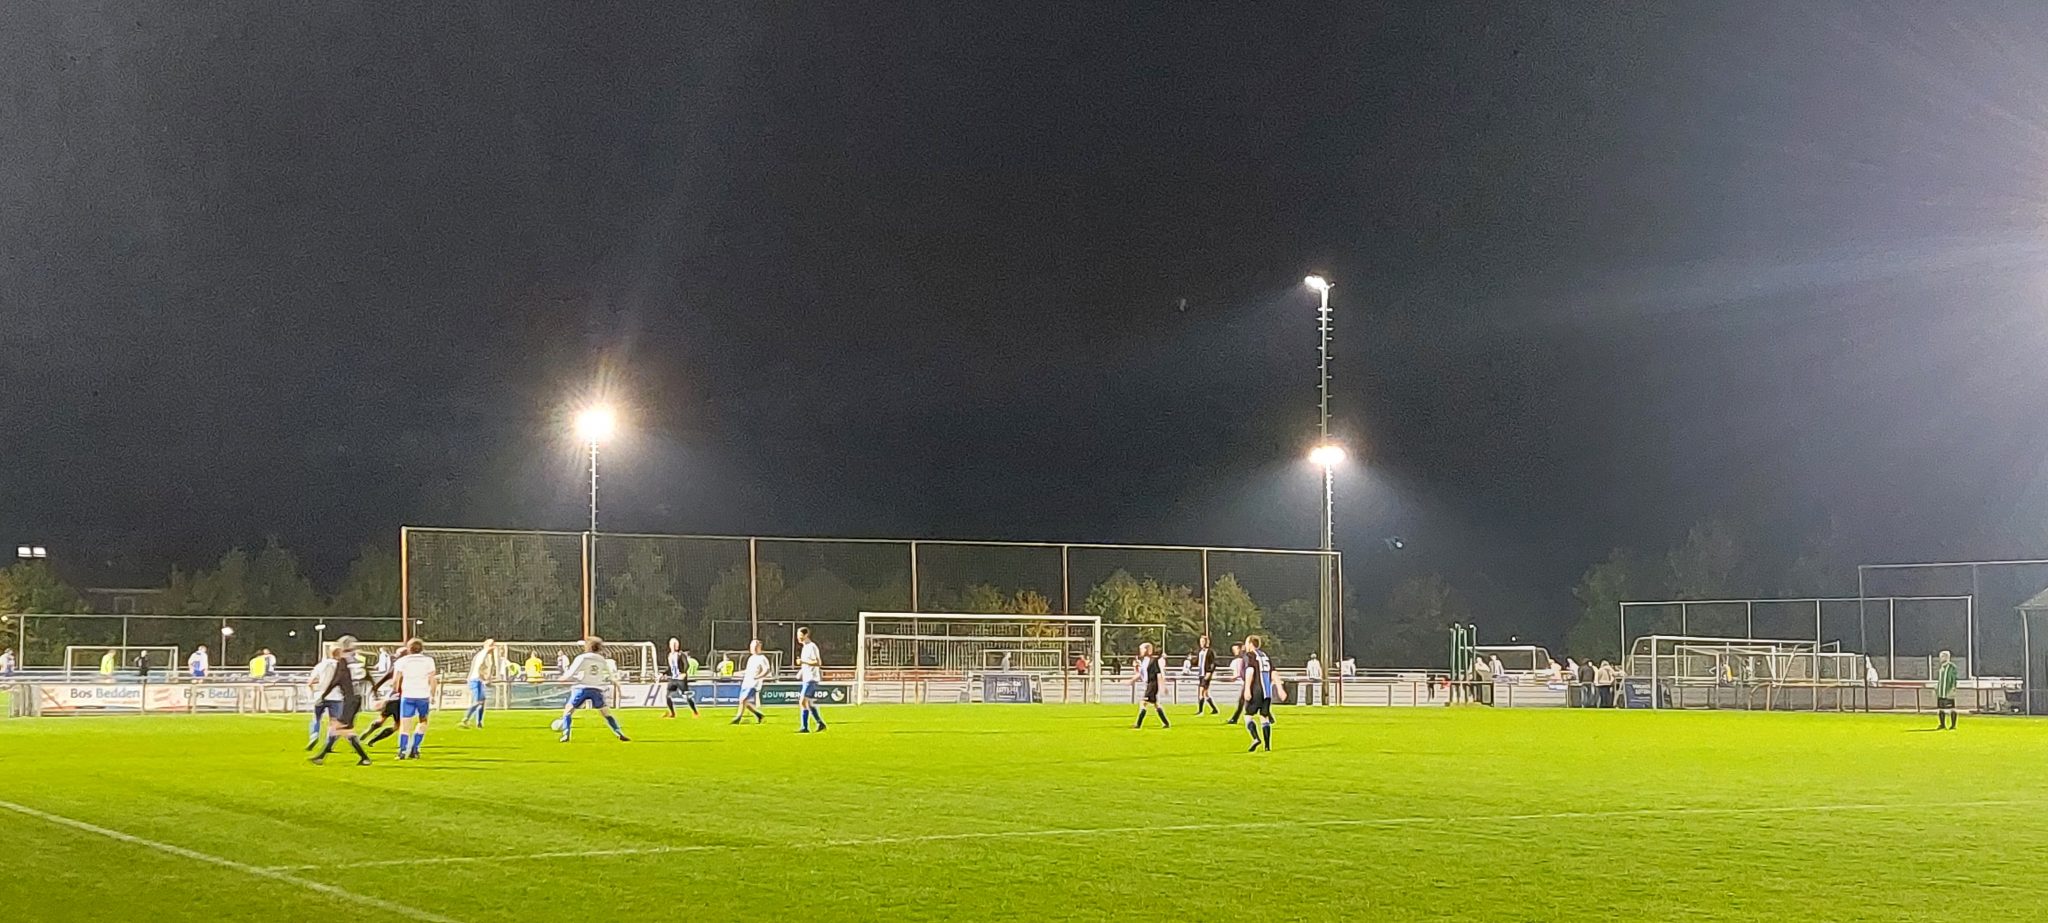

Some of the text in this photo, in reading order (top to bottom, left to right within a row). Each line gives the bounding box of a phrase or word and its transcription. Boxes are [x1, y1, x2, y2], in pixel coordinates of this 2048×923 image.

[70, 688, 140, 698] Bos Bedden
[183, 688, 205, 699] Bs
